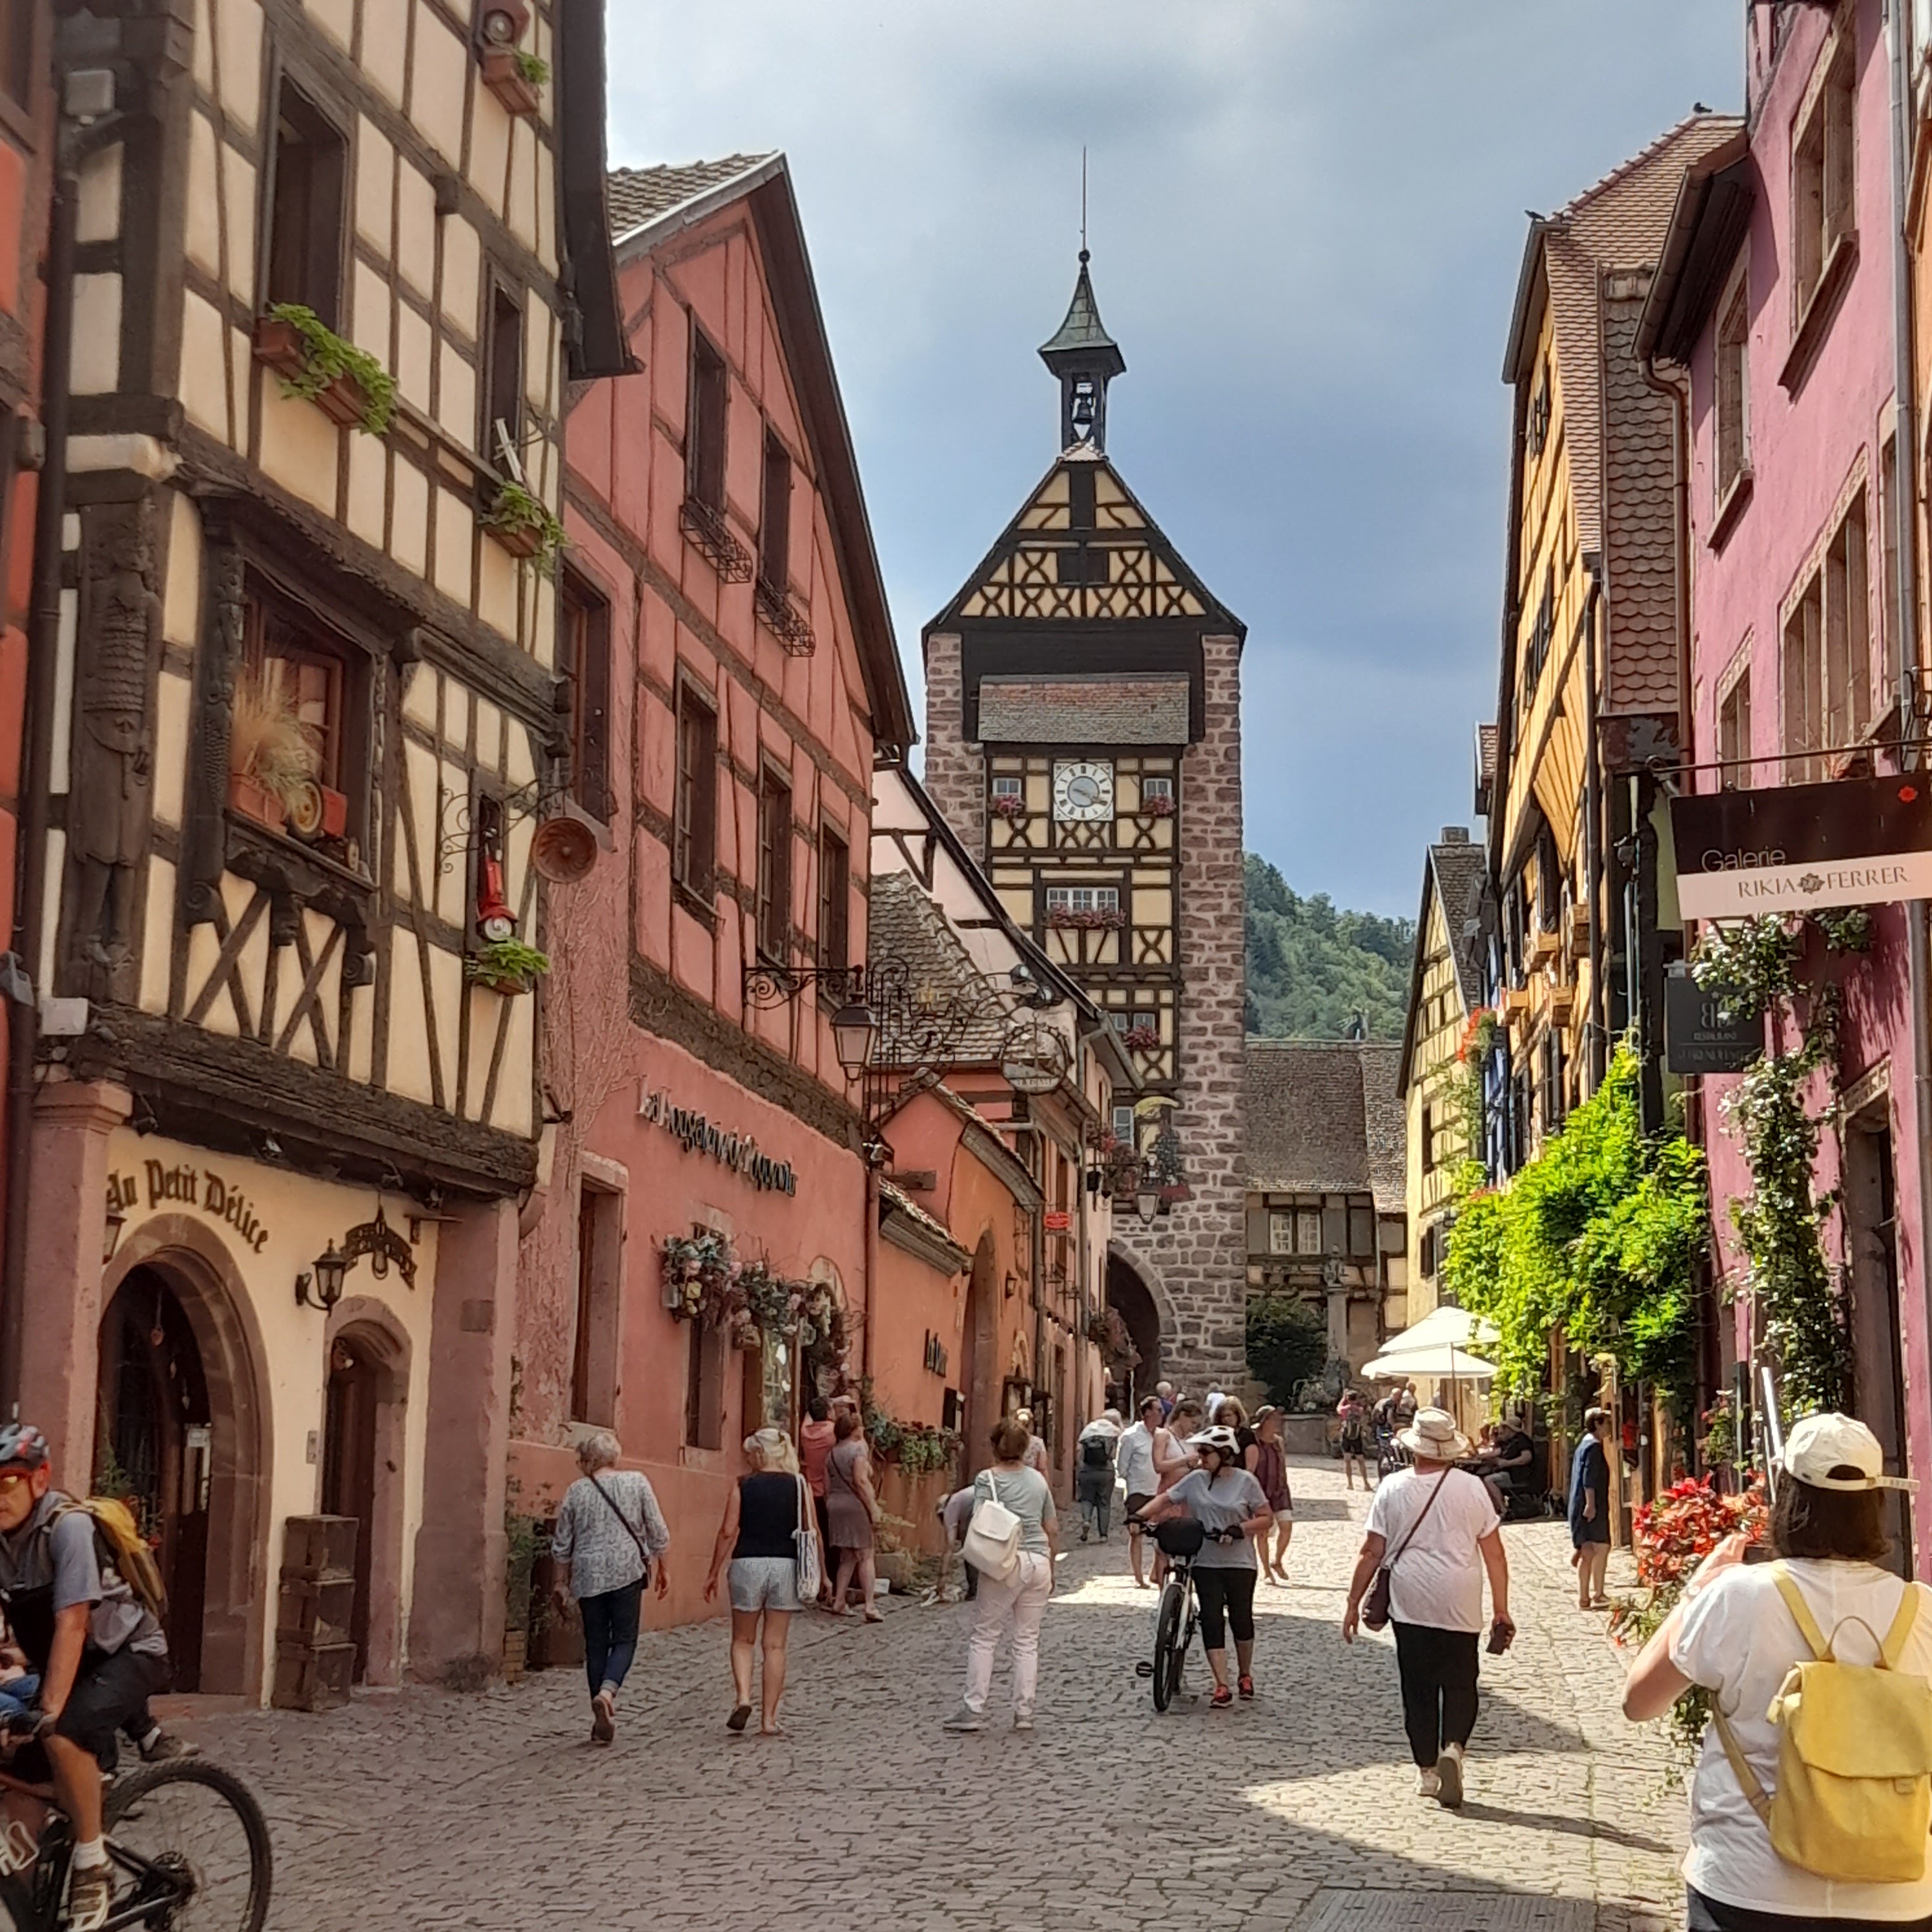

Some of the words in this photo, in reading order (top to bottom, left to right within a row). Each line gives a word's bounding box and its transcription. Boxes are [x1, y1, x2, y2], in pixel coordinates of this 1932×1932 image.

[1701, 846, 1786, 872] Galerie
[1738, 877, 1796, 899] RIKIA
[1827, 867, 1911, 890] FERRER
[107, 1169, 138, 1211] Au
[144, 1158, 198, 1209] Petit
[204, 1169, 268, 1253] Délice
